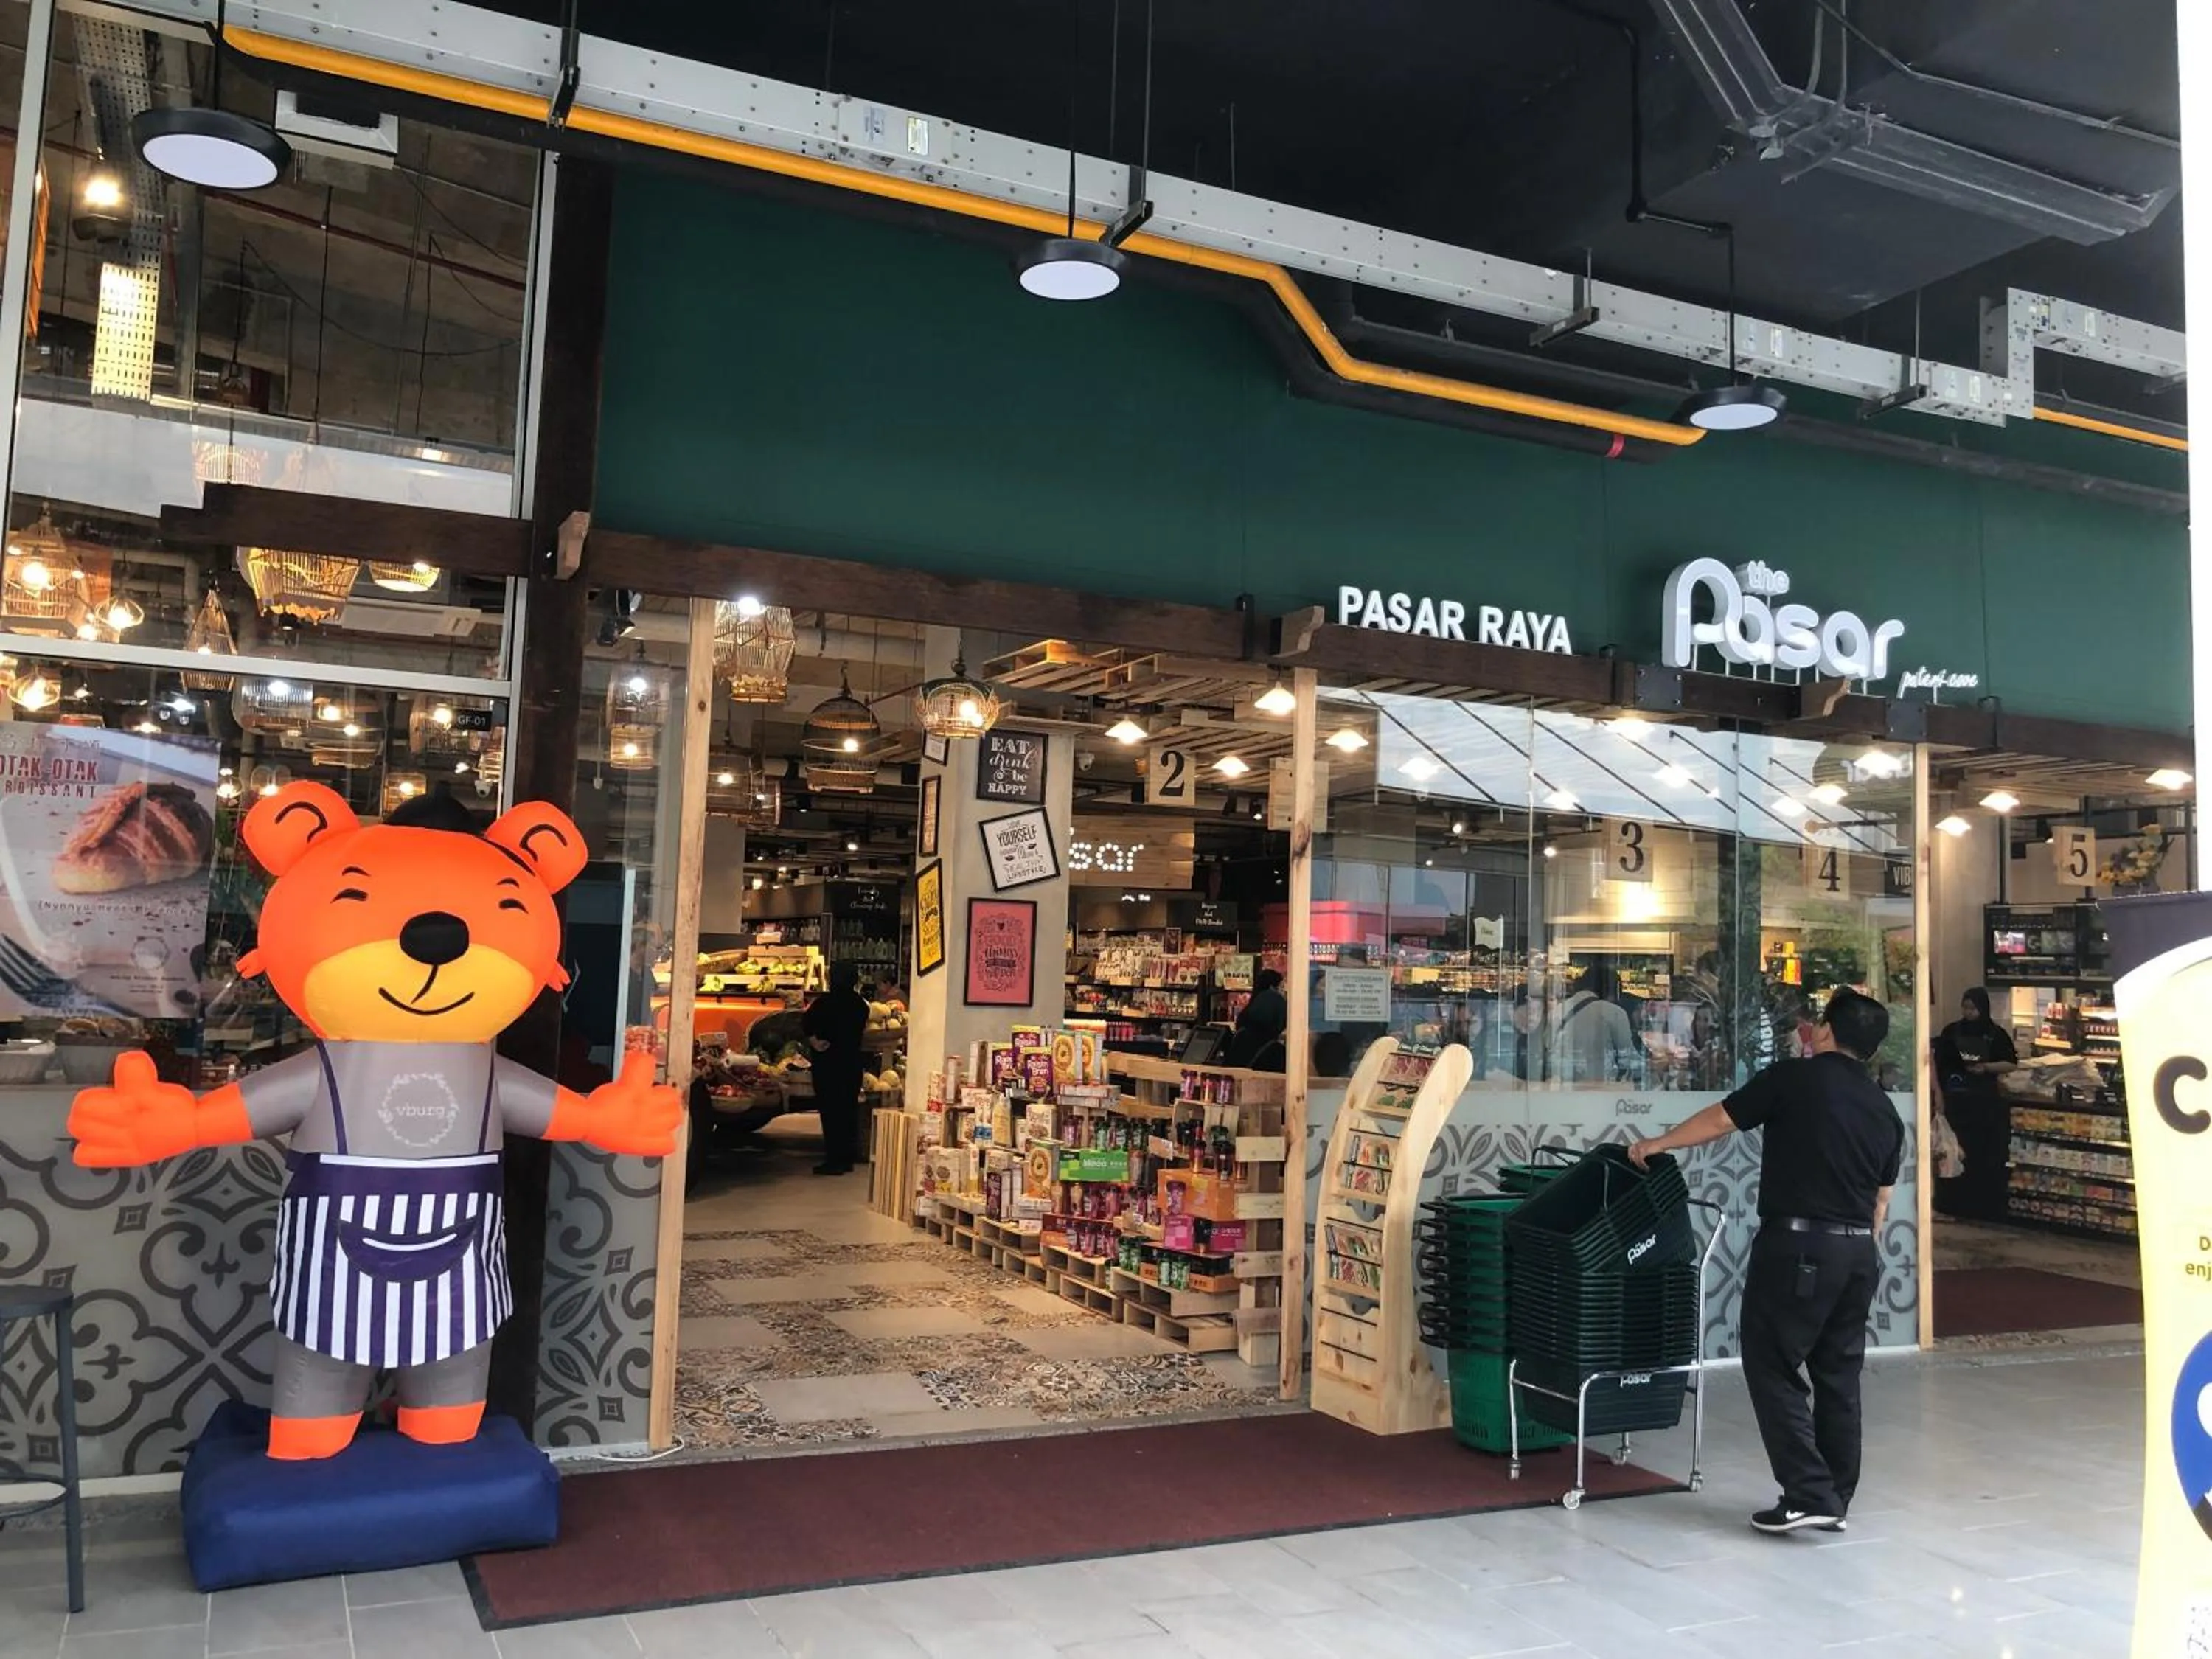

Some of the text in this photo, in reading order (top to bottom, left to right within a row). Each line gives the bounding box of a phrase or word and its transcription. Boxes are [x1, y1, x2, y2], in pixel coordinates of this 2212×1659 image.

[1736, 560, 1790, 595] the
[1339, 586, 1572, 655] PASAR RAYA
[1663, 558, 1905, 678] Pasar
[989, 747, 1036, 771] drink
[991, 737, 1030, 754] EAT
[52, 759, 97, 781] OTAK
[1012, 770, 1027, 782] be
[1159, 751, 1185, 796] 2
[988, 783, 1027, 795] HAPPY
[996, 825, 1037, 847] YOURSELF
[1619, 821, 1644, 872] 3
[1818, 847, 1841, 891] 4
[2070, 834, 2088, 877] 5
[1615, 1099, 1653, 1116] Pasar
[1627, 1234, 1656, 1265] Pasar
